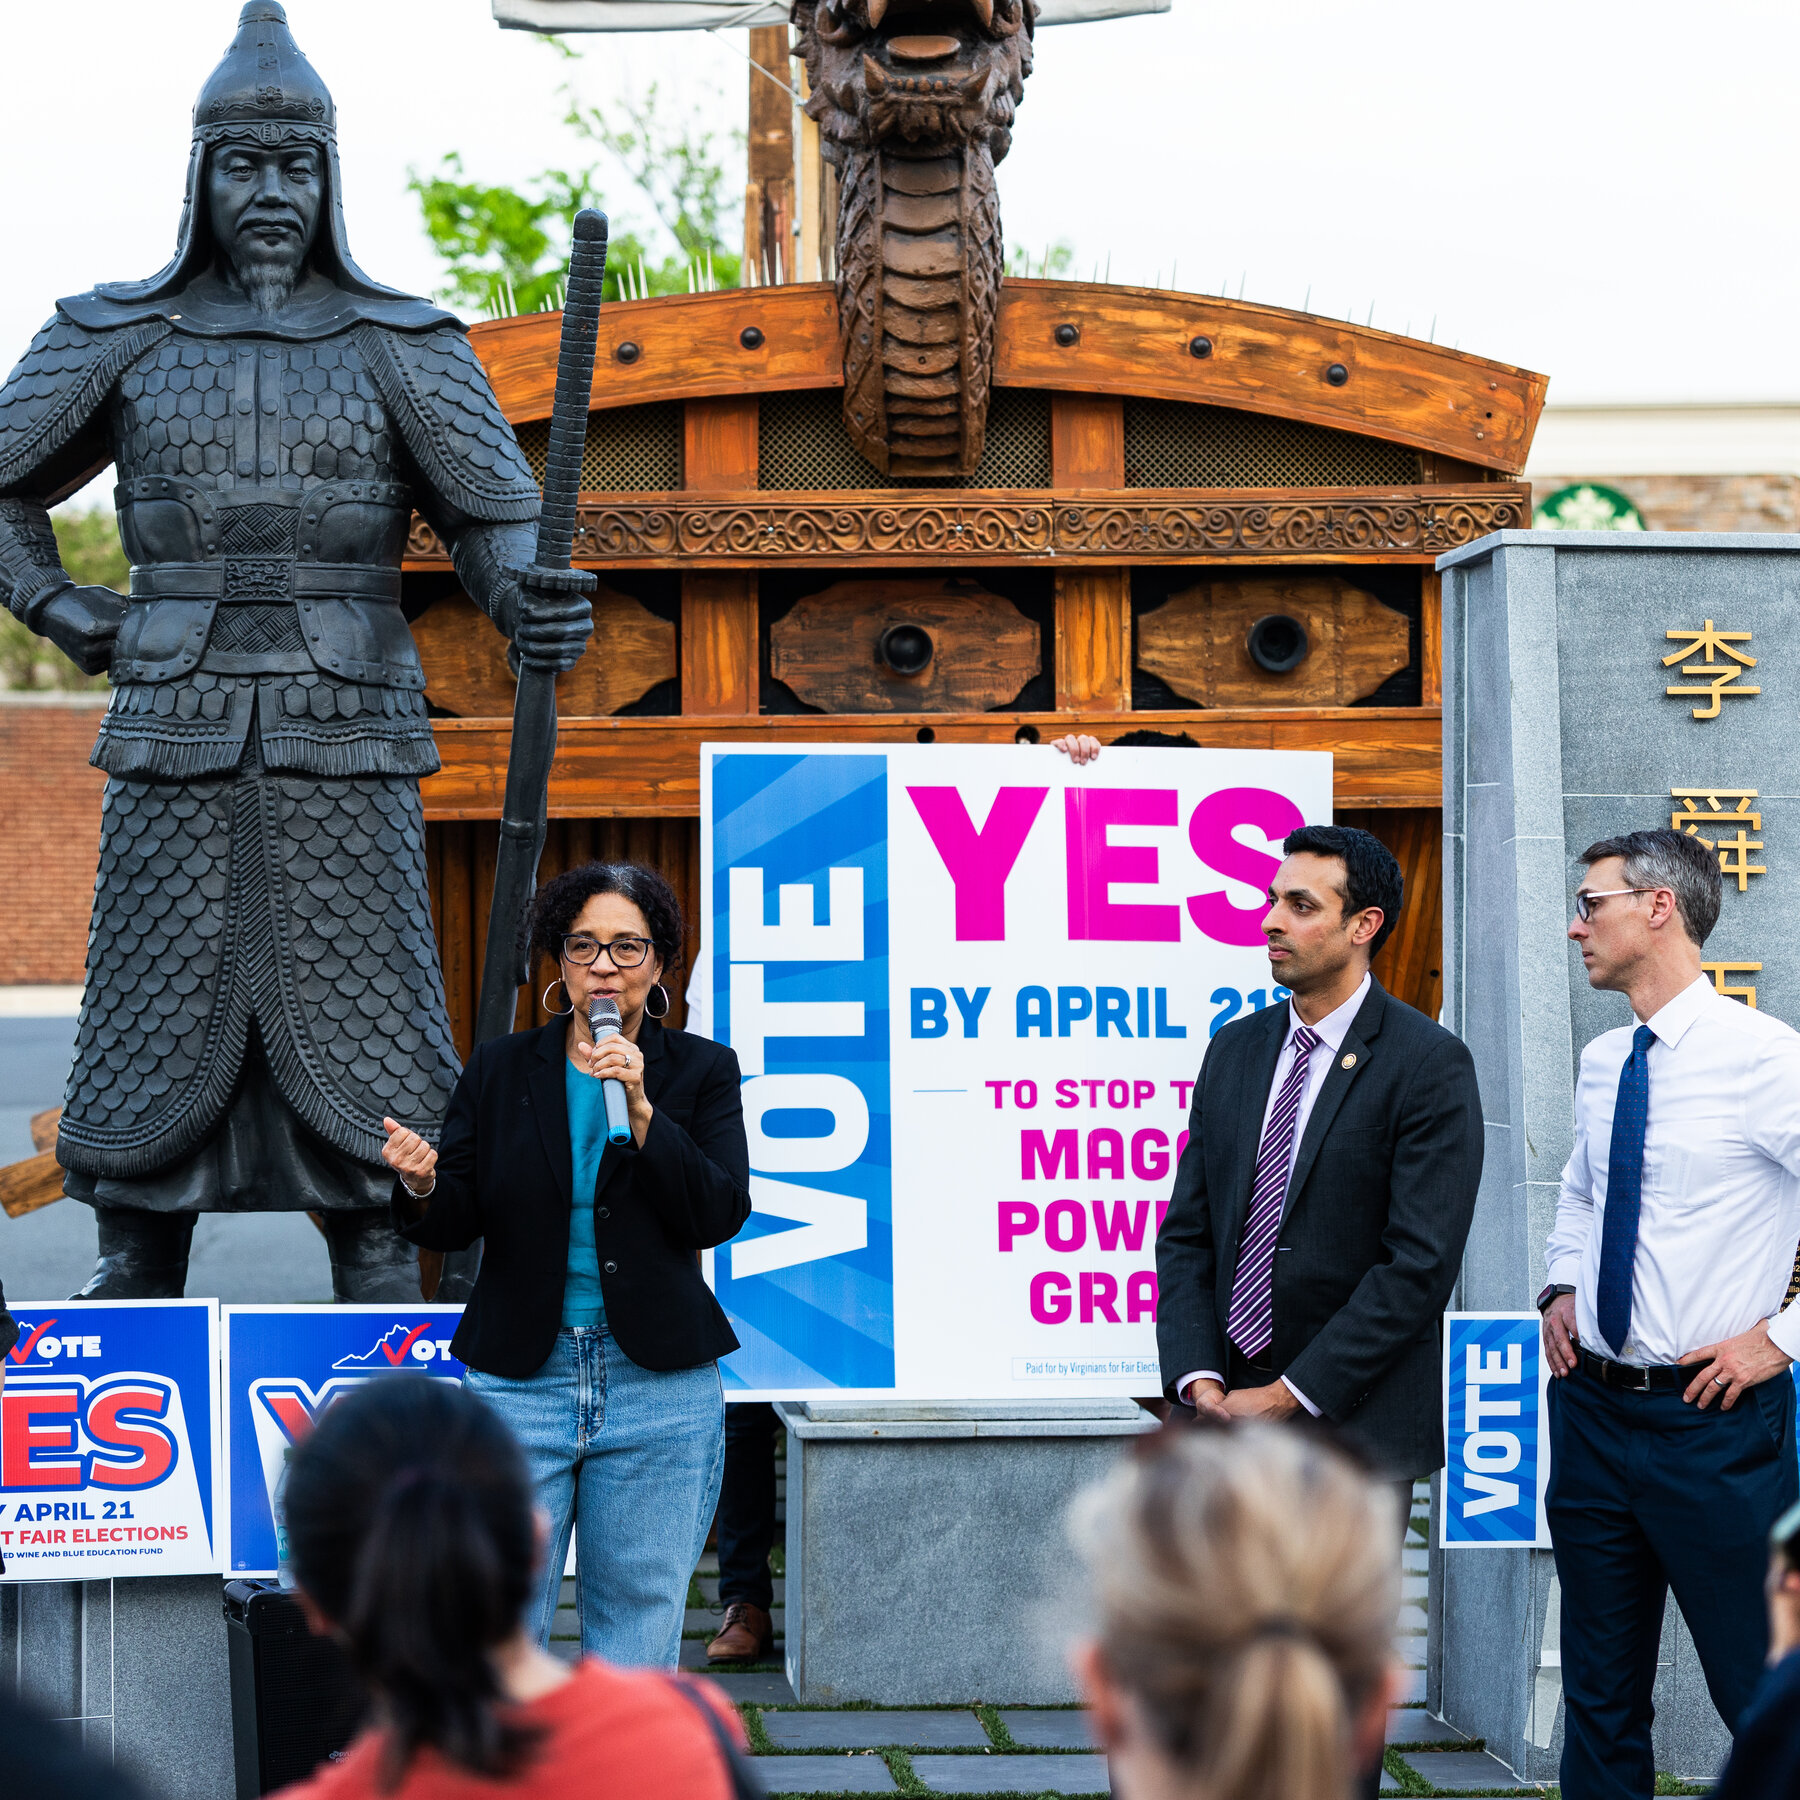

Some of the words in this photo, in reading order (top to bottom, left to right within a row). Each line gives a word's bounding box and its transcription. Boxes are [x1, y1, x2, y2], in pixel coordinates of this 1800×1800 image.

[905, 785, 1306, 947] YES
[910, 986, 992, 1039] BY
[1015, 985, 1187, 1039] APRIL
[729, 867, 870, 1280] VOTE
[984, 1079, 1038, 1110] TO
[1055, 1079, 1156, 1109] STOP
[1029, 1270, 1160, 1325] GRA
[1025, 1362, 1043, 1374] Paid
[1045, 1362, 1056, 1374] for
[1058, 1362, 1068, 1376] by
[1070, 1361, 1107, 1376] Virginians
[1108, 1360, 1119, 1373] for
[1121, 1361, 1135, 1373] Fair
[1463, 1343, 1523, 1519] VOTE
[14, 1502, 95, 1522] APRIL
[102, 1500, 135, 1519] 21
[16, 1551, 40, 1559] WINE
[41, 1550, 61, 1558] AND
[86, 1548, 138, 1557] EDUCATION
[139, 1547, 163, 1555] FUND
[20, 1529, 66, 1545] FAIR
[72, 1525, 189, 1543] ELECTIONS
